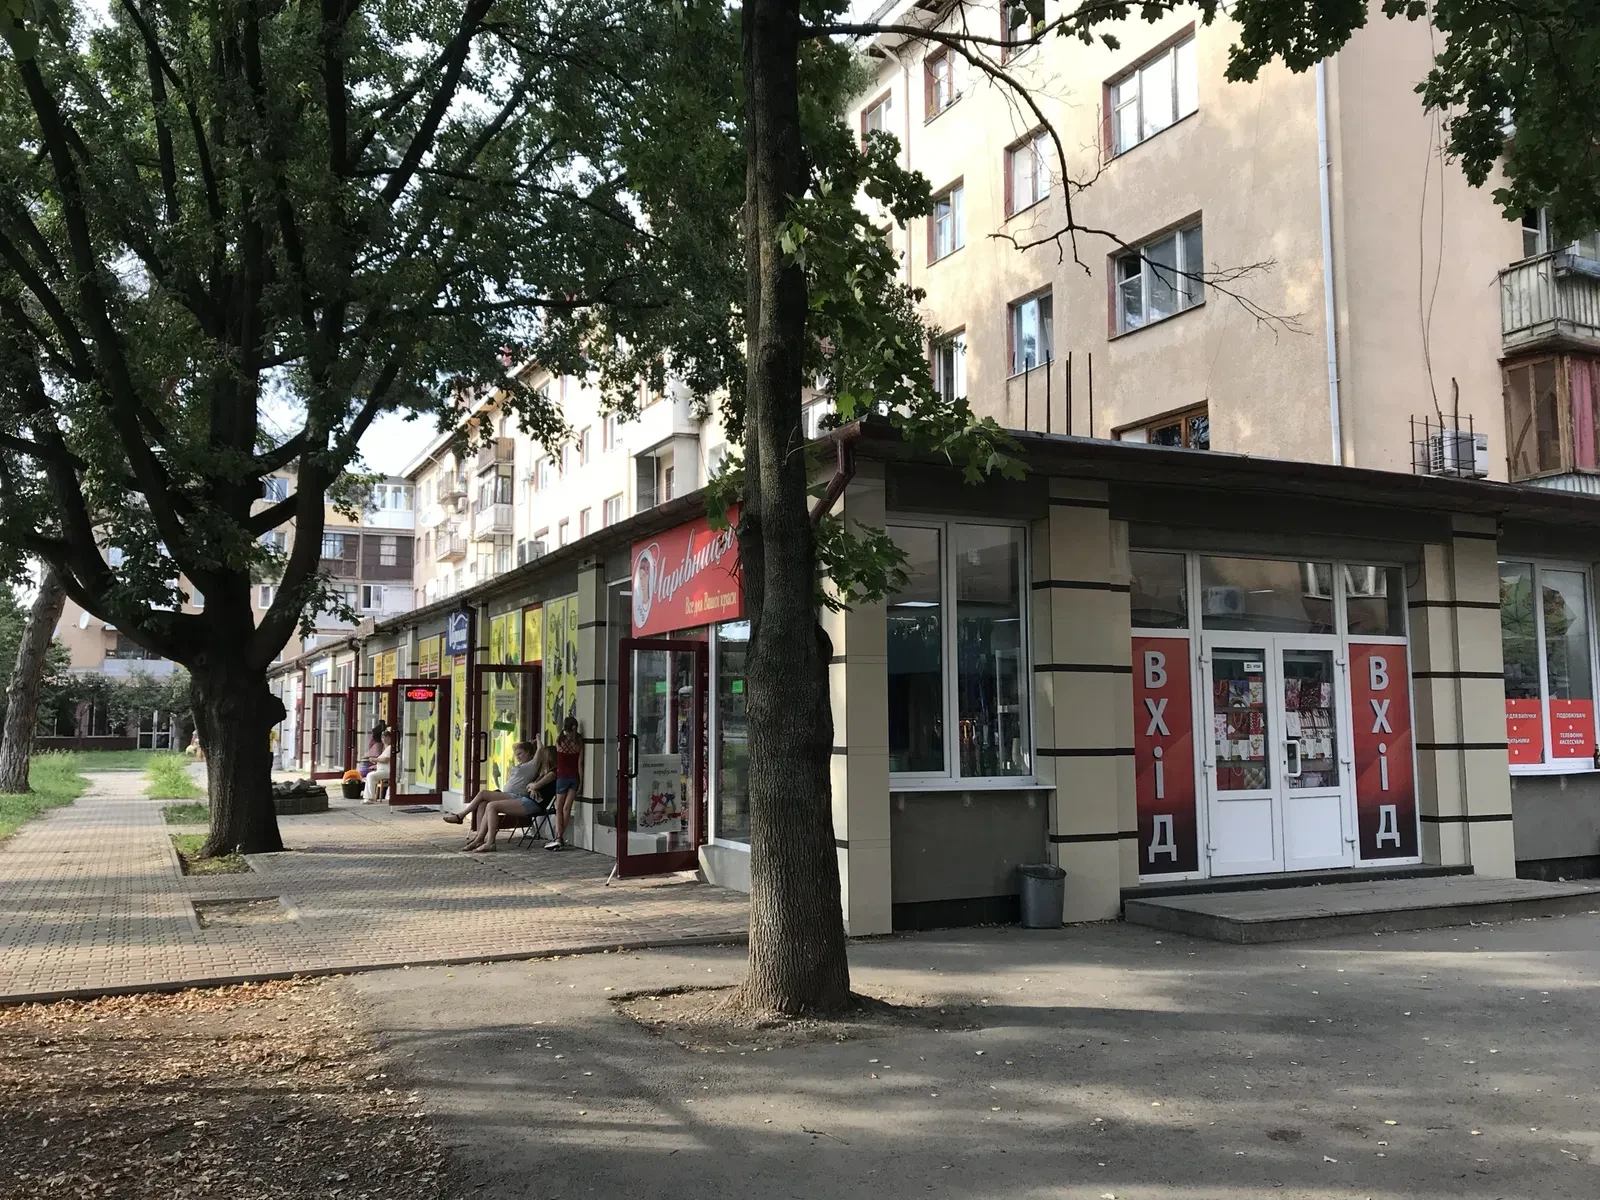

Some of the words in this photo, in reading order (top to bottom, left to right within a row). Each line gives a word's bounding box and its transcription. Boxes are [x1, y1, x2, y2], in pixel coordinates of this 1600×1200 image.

[685, 597, 694, 615] Все
[694, 599, 703, 618] для
[704, 590, 720, 610] Вашої
[720, 592, 737, 614] краси
